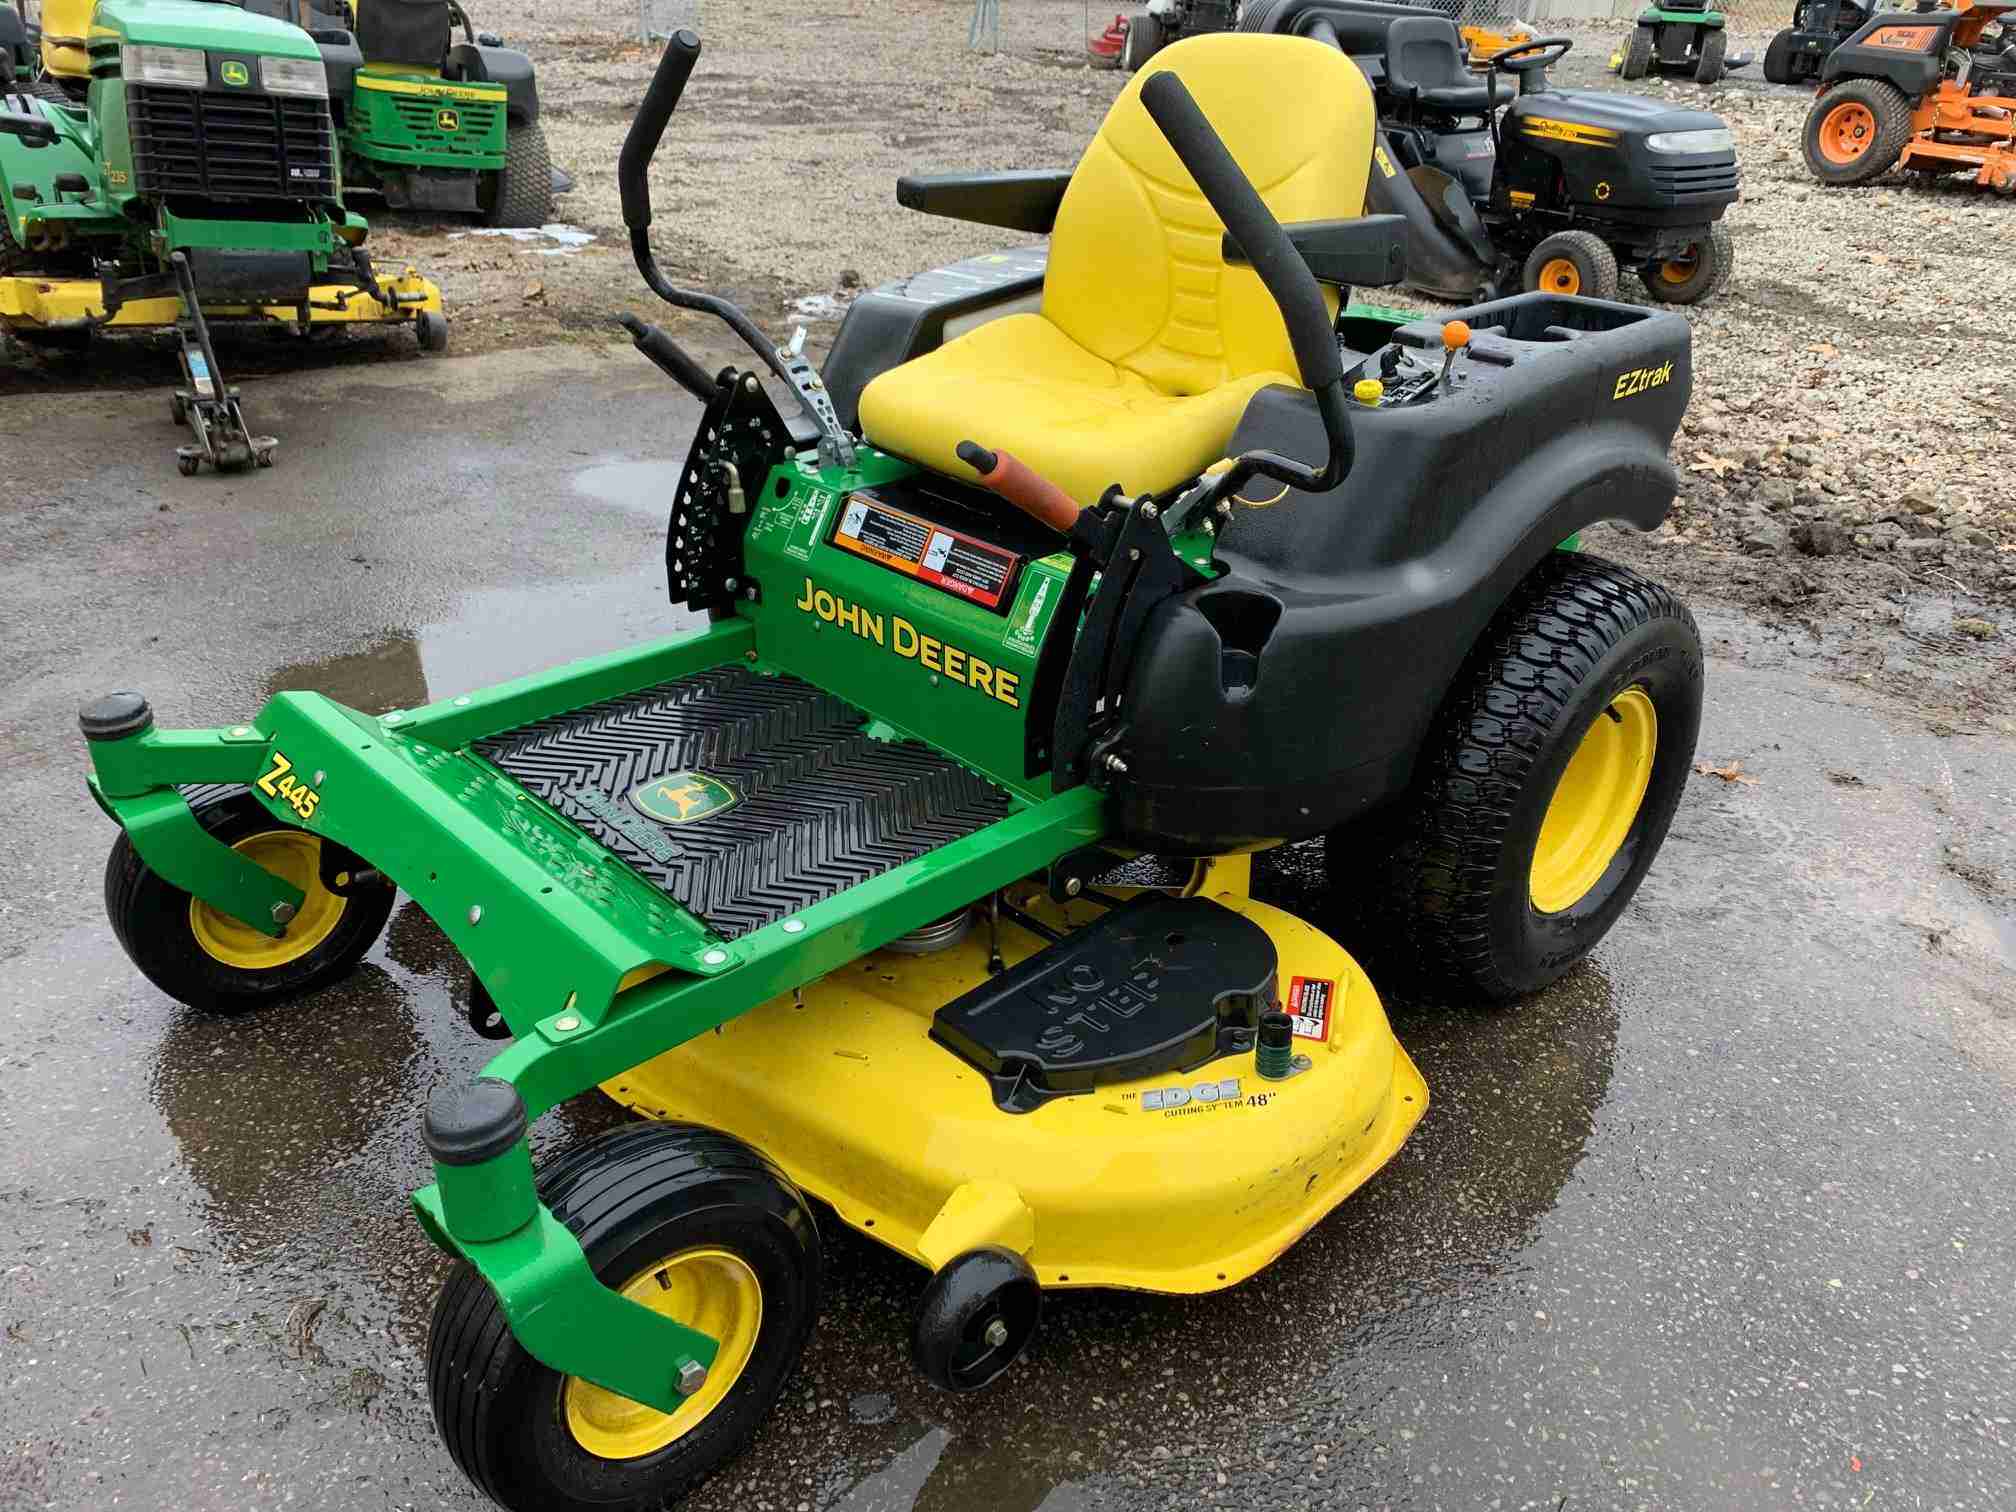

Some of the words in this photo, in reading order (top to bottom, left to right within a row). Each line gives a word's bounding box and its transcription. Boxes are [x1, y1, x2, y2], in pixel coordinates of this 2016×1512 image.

[1613, 360, 1675, 400] EZtrak
[797, 576, 885, 646] JOHN
[892, 617, 1021, 708] DEERE
[256, 752, 321, 819] Z445
[1025, 964, 1105, 1015] NO
[1035, 957, 1161, 1059] STEP
[1121, 1091, 1137, 1102] THE
[1142, 1078, 1242, 1112] EDGE
[1164, 1105, 1204, 1118] CUTTING
[1205, 1099, 1244, 1113] SYTEM
[1246, 1092, 1277, 1107] 48"
